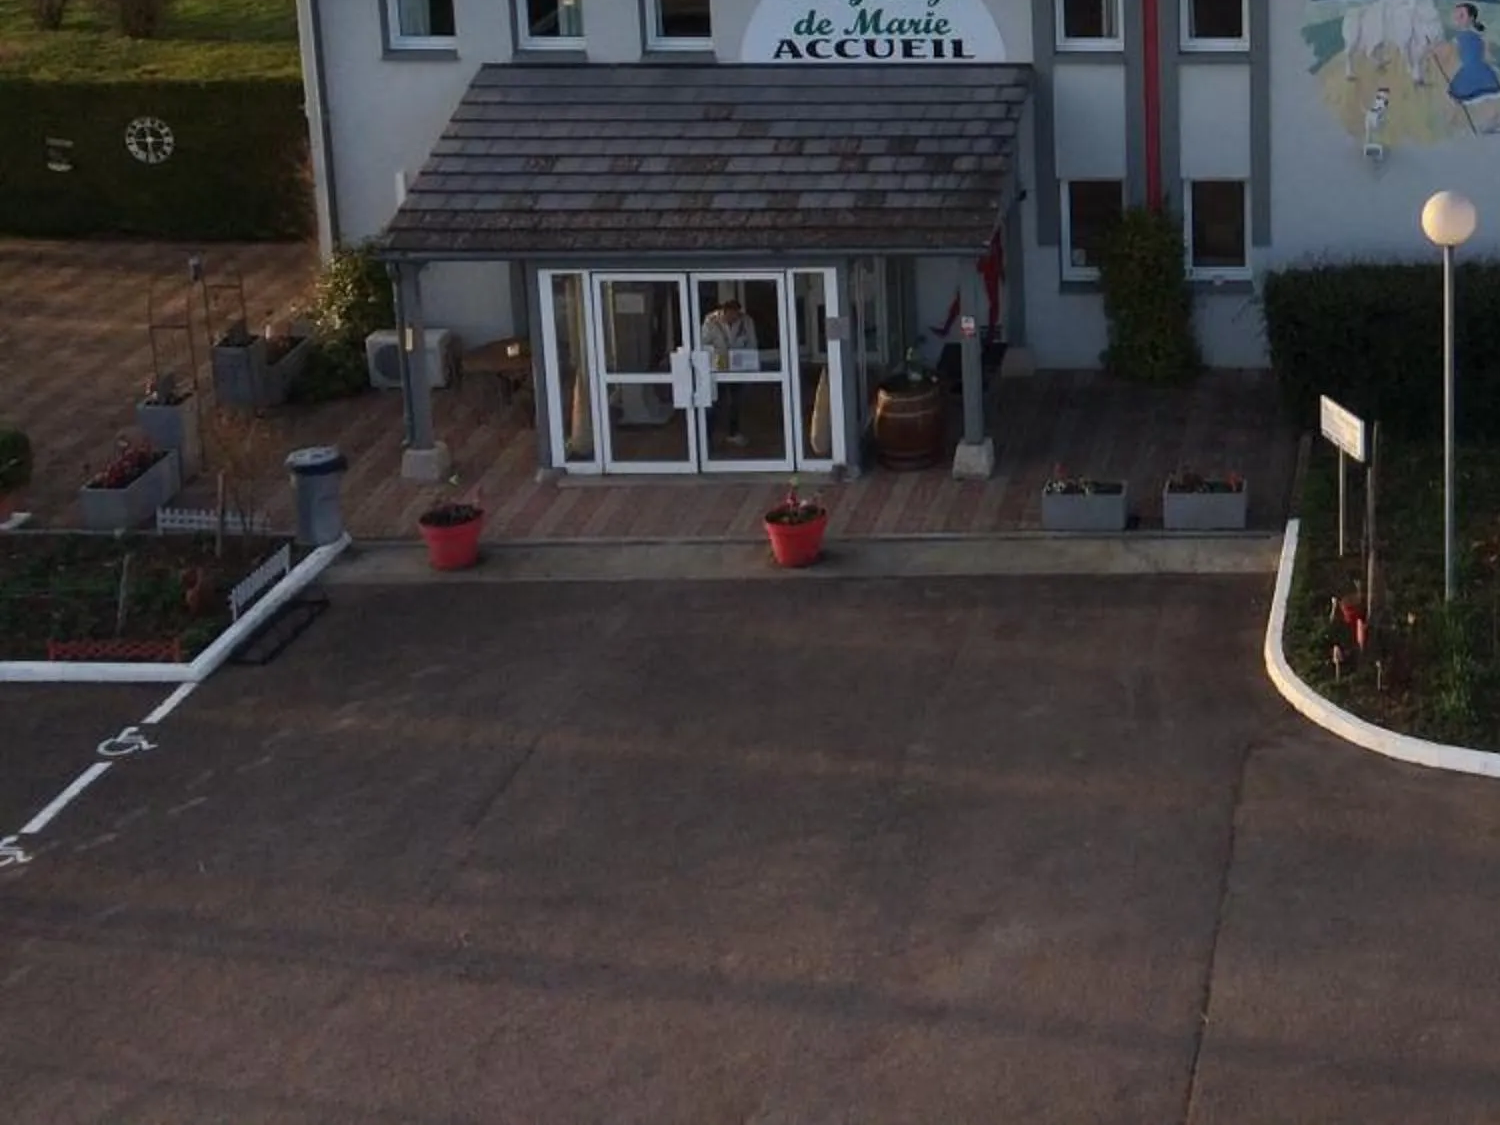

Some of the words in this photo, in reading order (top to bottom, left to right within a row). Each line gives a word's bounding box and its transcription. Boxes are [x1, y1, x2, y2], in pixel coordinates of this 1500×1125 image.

[793, 10, 834, 36] de
[844, 8, 951, 36] Marie
[772, 38, 976, 59] ACCUEIL
